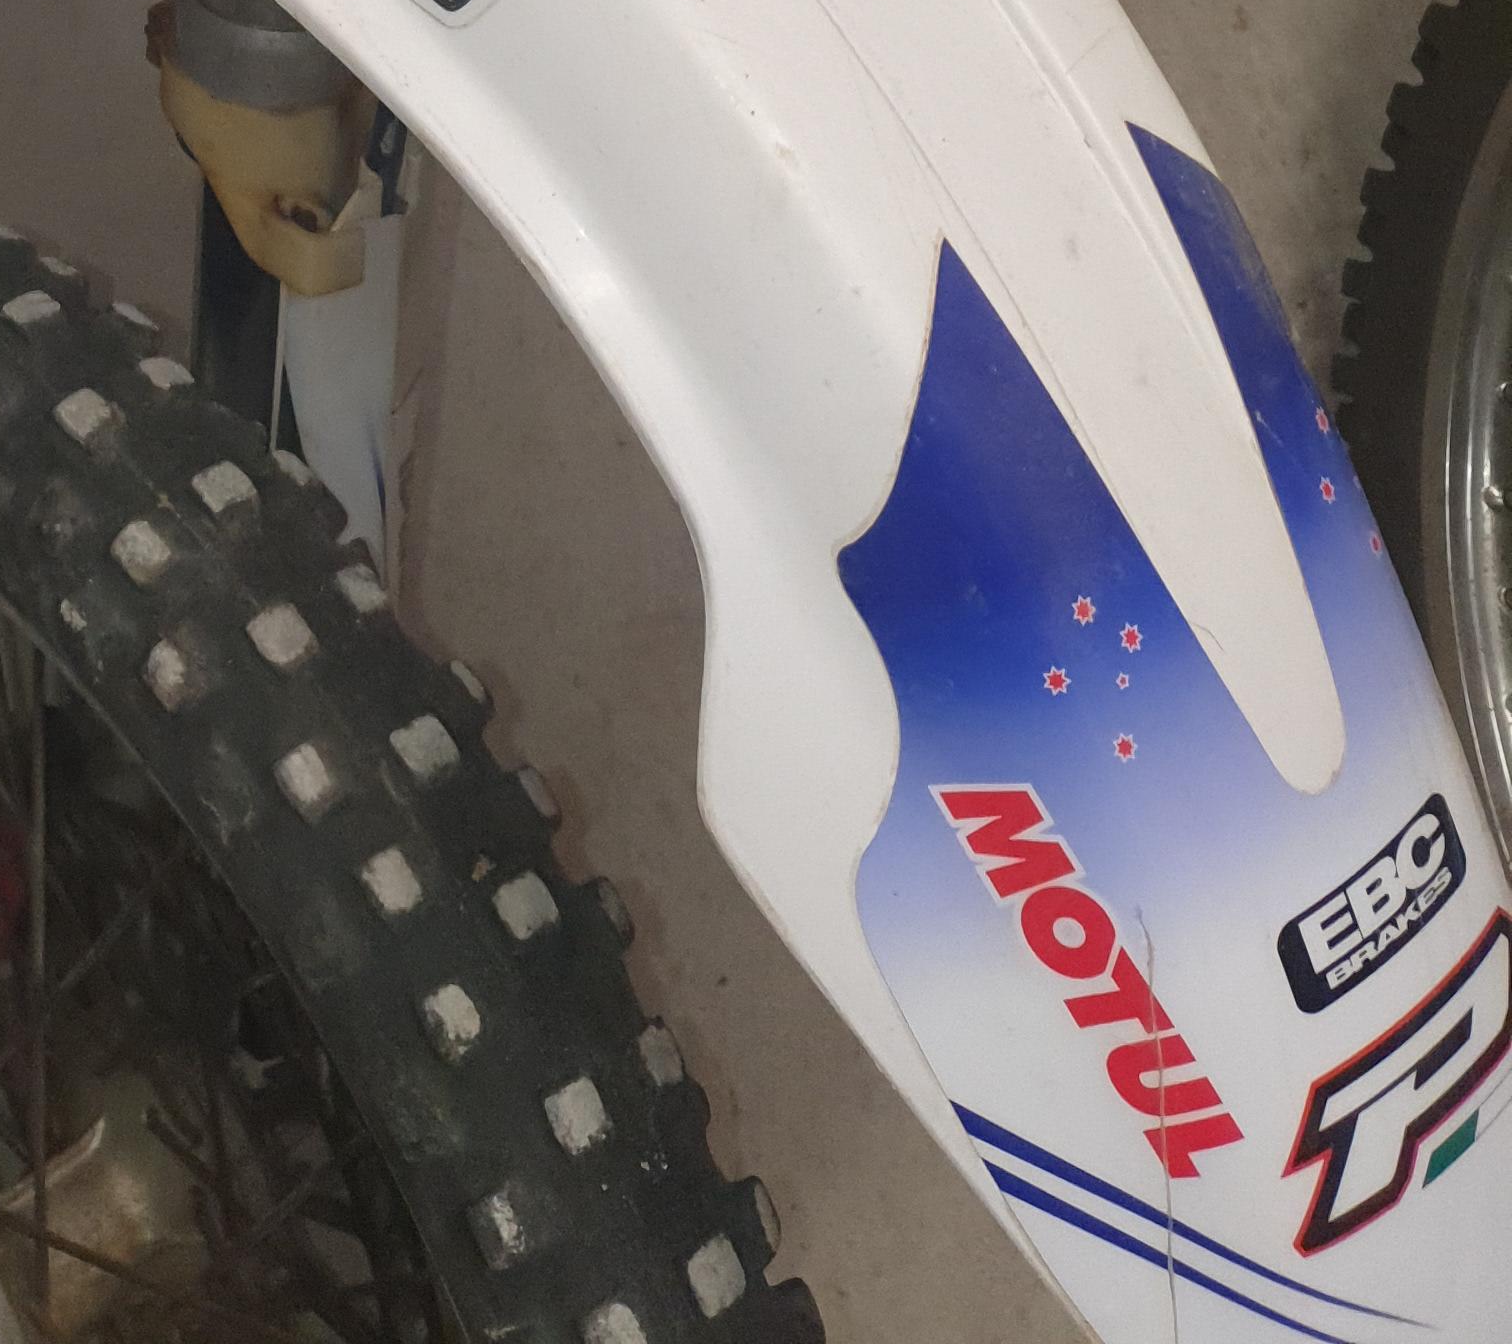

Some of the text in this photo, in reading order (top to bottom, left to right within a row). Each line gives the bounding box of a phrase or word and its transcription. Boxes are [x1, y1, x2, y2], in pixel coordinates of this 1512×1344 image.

[1297, 812, 1446, 976] EBC
[1325, 866, 1453, 991] BRAKES
[930, 783, 1245, 1180] MOTUL
